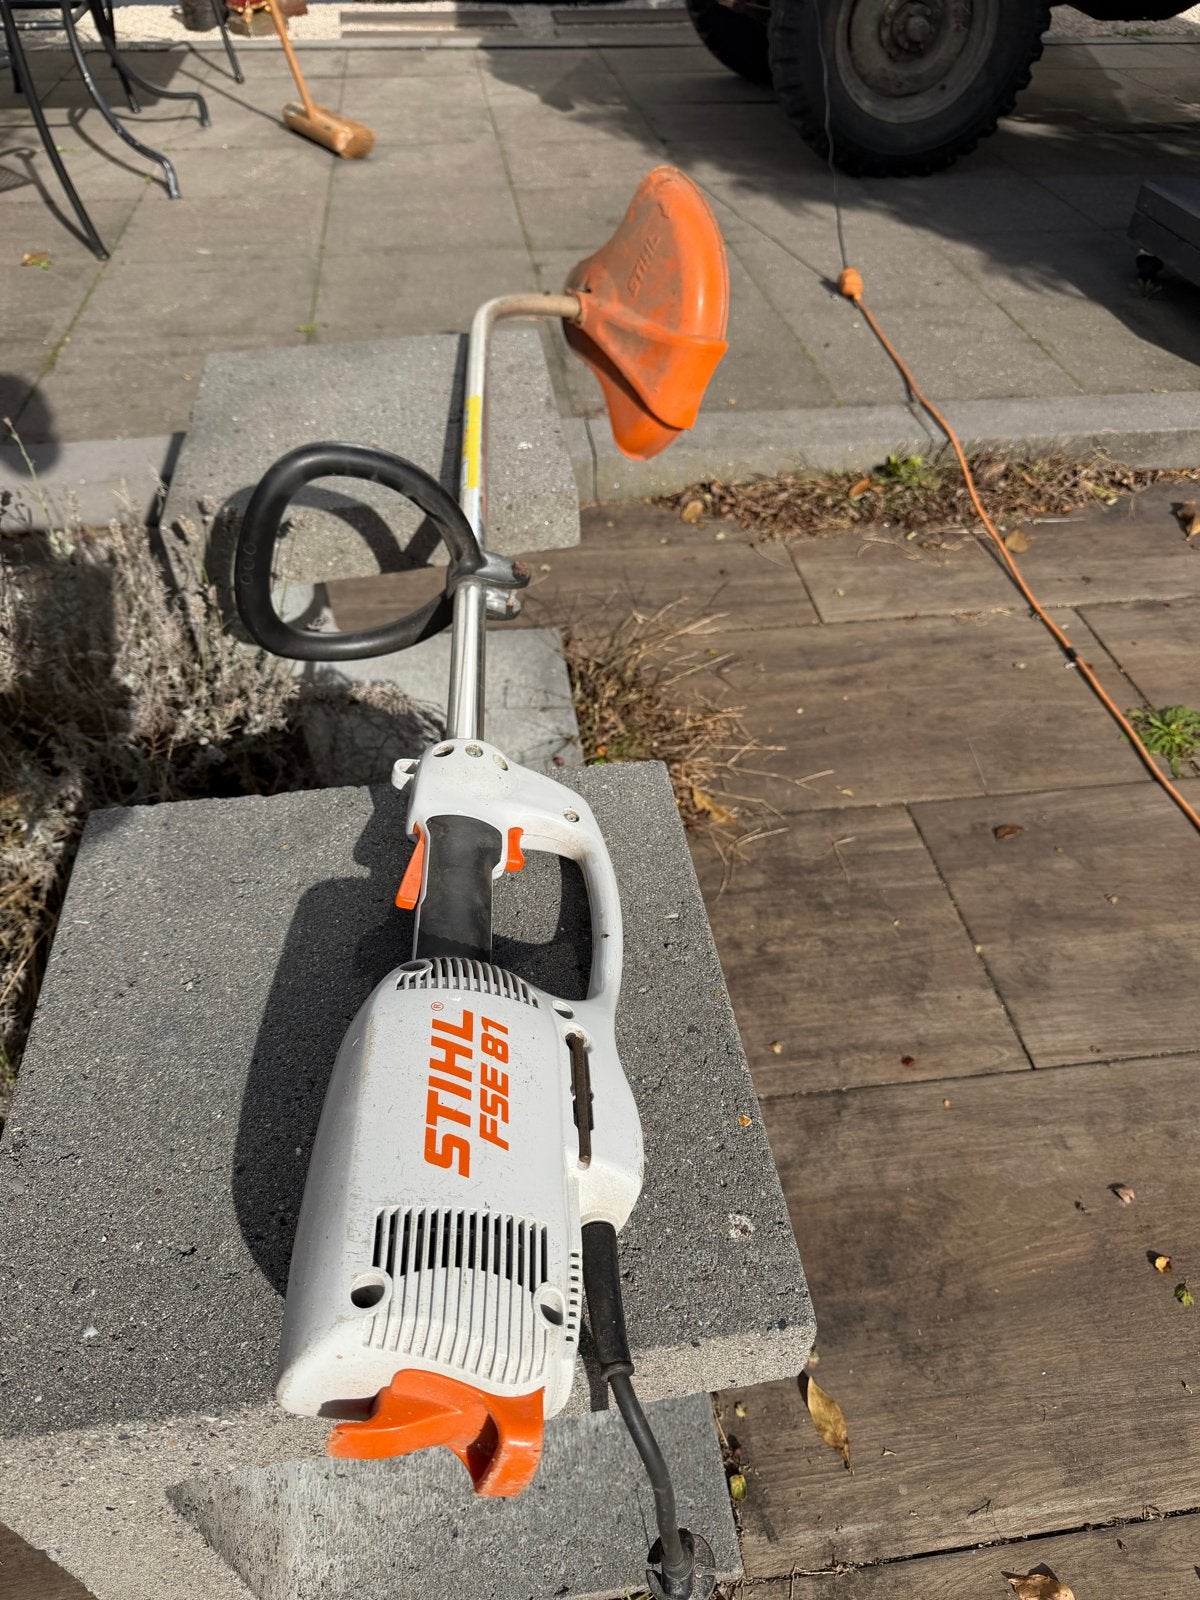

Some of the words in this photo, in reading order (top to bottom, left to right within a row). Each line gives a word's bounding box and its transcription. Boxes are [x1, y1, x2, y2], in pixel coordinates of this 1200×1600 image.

[627, 235, 661, 298] STIHL
[480, 1016, 509, 1064] 81
[424, 1009, 473, 1178] STIHL
[479, 1062, 509, 1151] FSE
